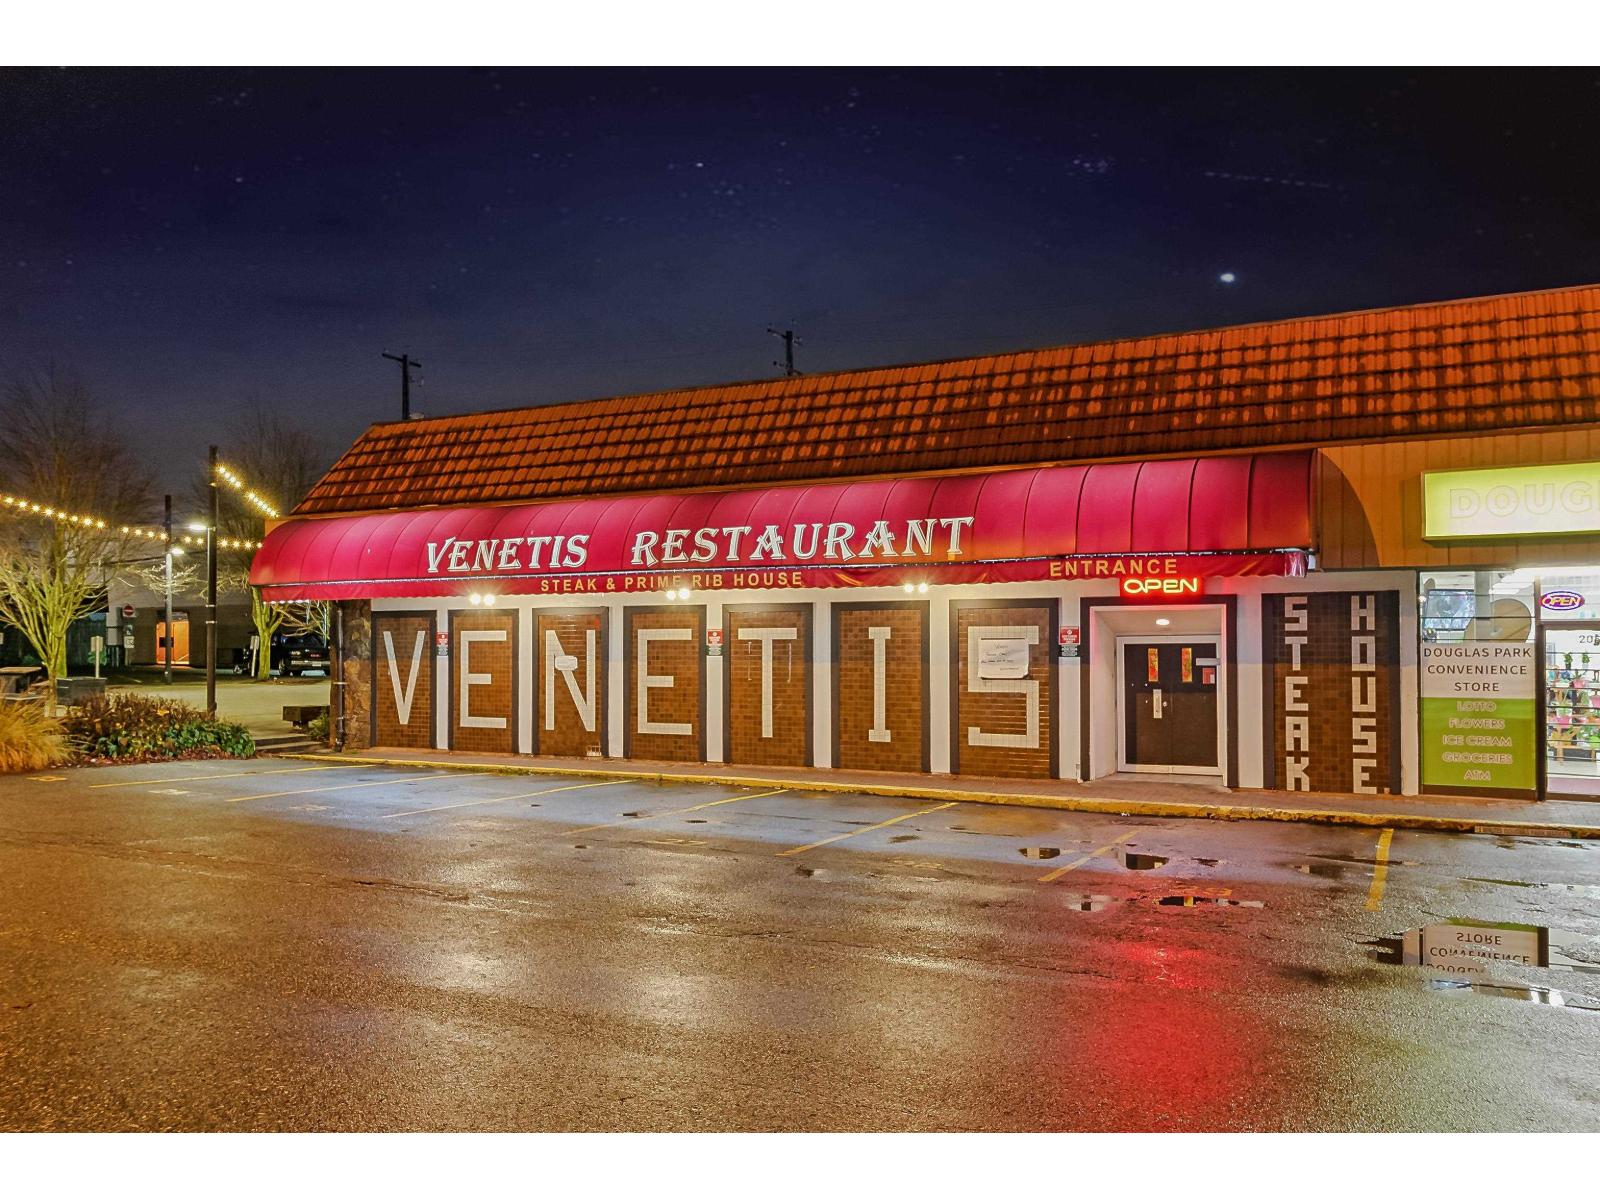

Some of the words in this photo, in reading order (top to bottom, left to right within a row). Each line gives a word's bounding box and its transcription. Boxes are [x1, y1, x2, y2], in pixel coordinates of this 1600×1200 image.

[1450, 480, 1600, 519] DOUG
[427, 534, 590, 573] VENETIS
[630, 516, 975, 567] RESTAURANT
[1050, 558, 1177, 577] ENTRANCE
[540, 578, 597, 592] STEAK
[606, 577, 616, 590] &
[624, 574, 681, 589] PRIME
[692, 574, 723, 587] RIB
[733, 571, 802, 586] HOUSE
[1123, 577, 1198, 594] OPEN
[1541, 596, 1581, 607] OPEN
[1424, 647, 1490, 658] DOUGLAS
[1494, 647, 1532, 658] PARK
[1427, 664, 1527, 675] CONVENIENCE
[1454, 682, 1500, 692] STORE
[1284, 596, 1310, 792] STEAK
[1449, 718, 1505, 729] FLOWERS
[1442, 735, 1464, 746] ICE
[1466, 736, 1513, 747] CREAM
[1442, 751, 1513, 764] GROCERIES
